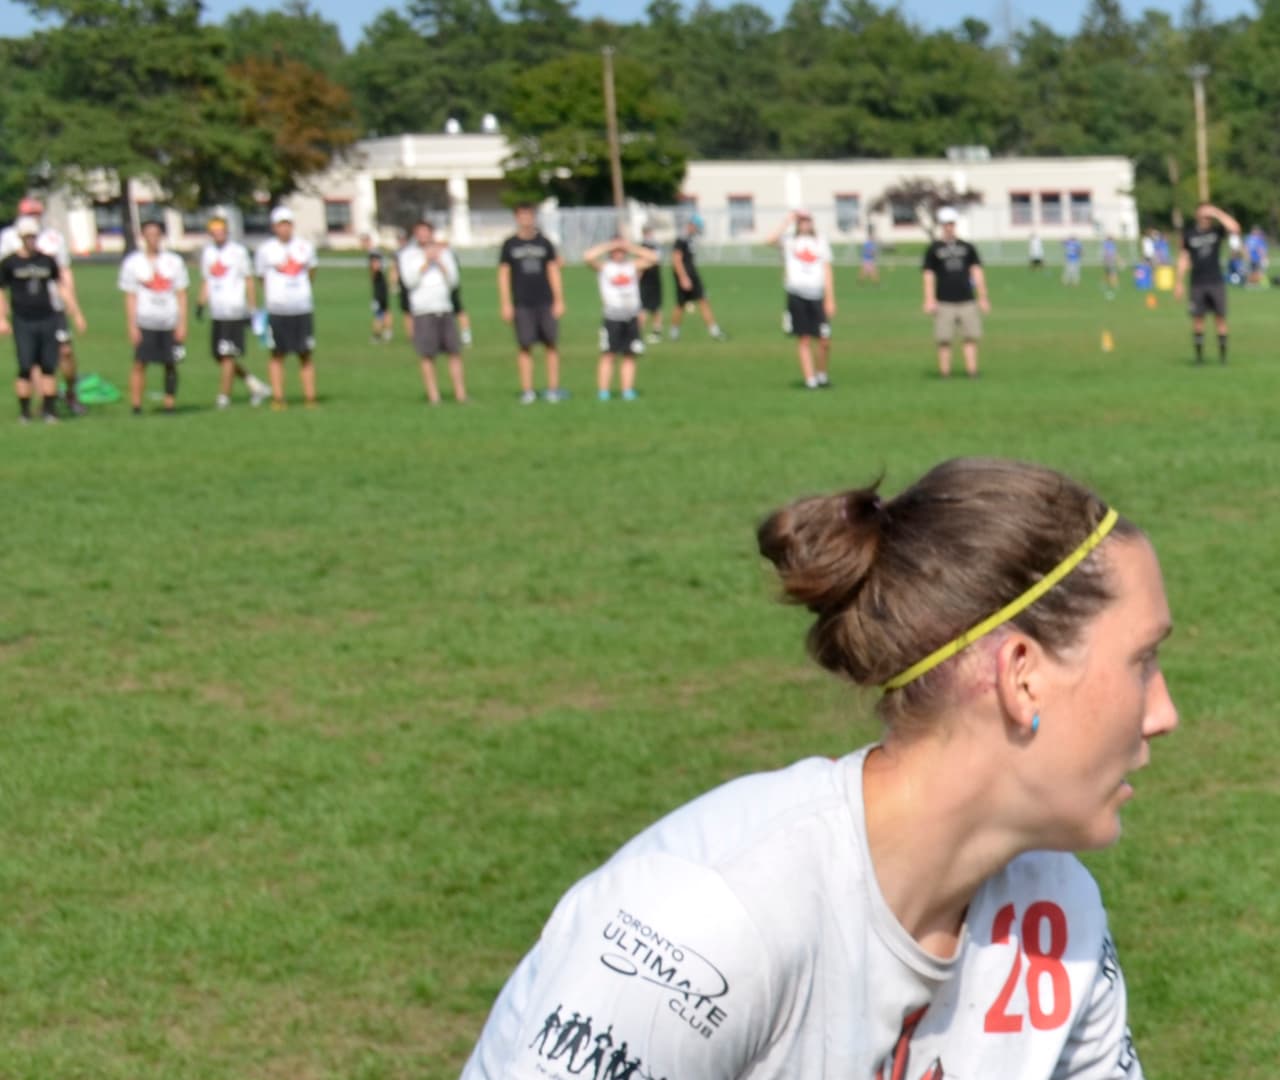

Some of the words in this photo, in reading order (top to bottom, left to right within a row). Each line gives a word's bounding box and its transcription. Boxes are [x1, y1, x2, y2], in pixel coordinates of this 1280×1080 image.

[603, 921, 728, 1029] ULTIMATE
[617, 909, 685, 962] TORONTO
[983, 900, 1073, 1033] 28
[667, 997, 714, 1040] CLUB
